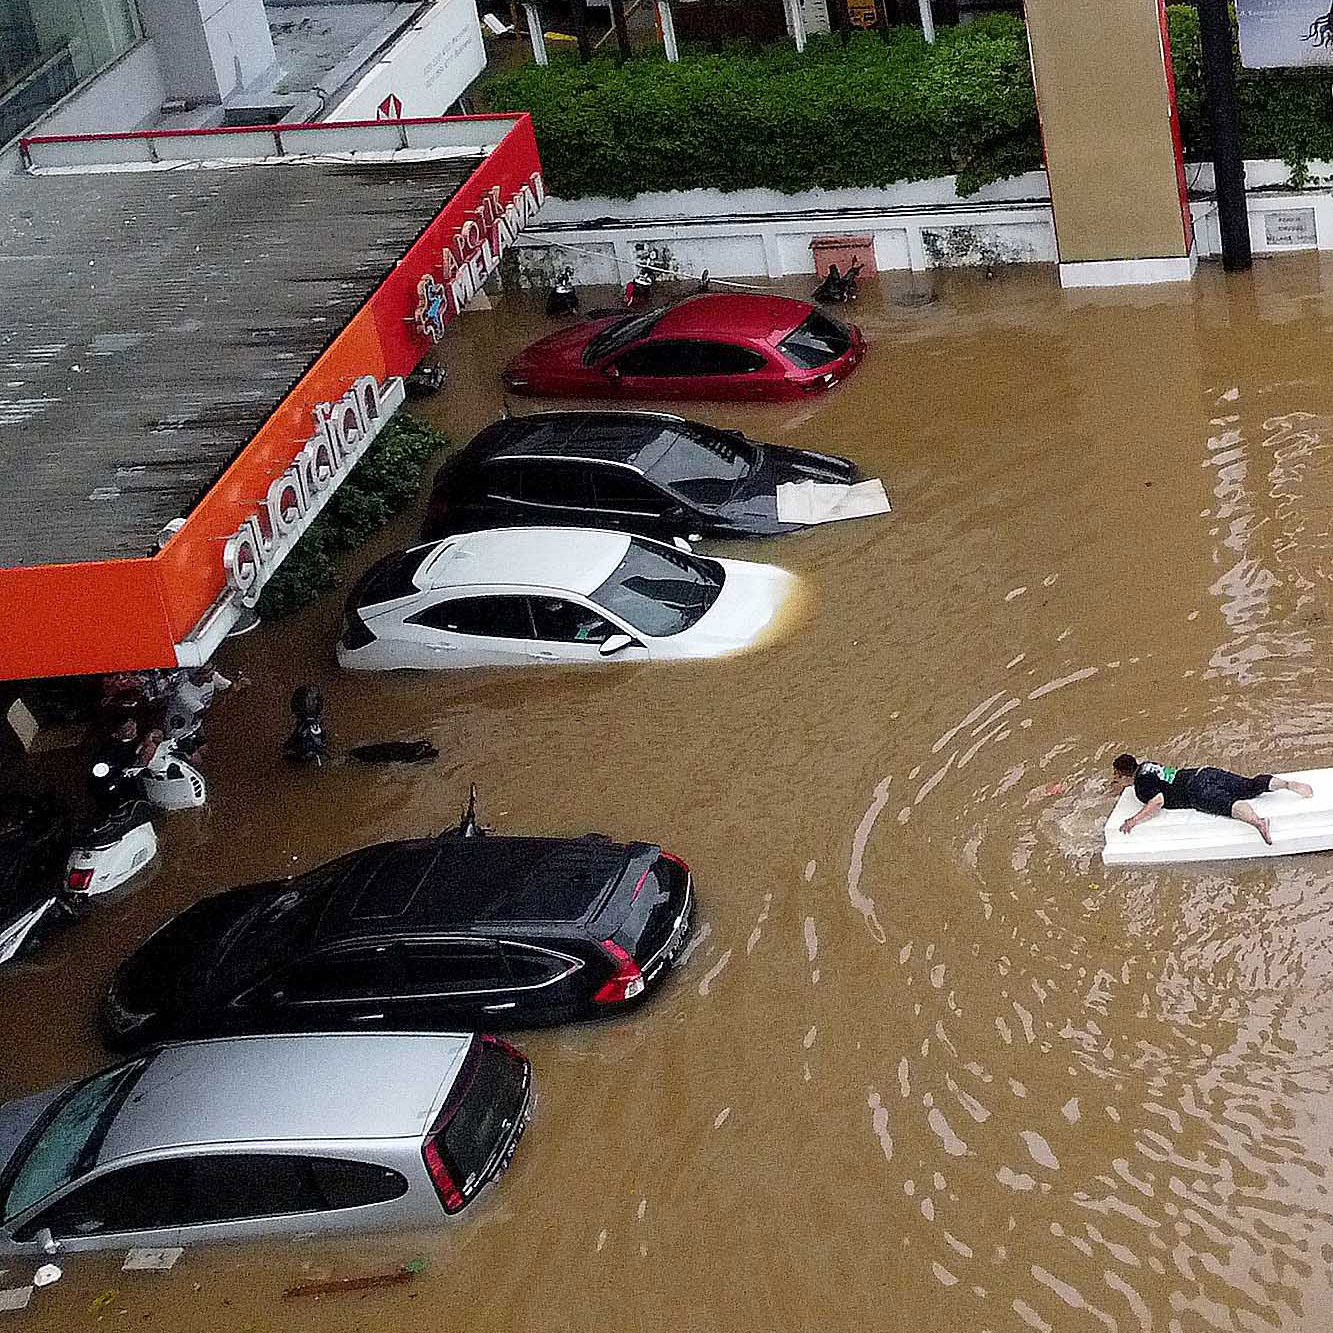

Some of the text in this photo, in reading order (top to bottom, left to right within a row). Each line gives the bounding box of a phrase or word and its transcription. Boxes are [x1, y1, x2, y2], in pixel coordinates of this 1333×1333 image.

[442, 185, 504, 281] APOTIK
[446, 171, 545, 315] MELAWAI
[223, 375, 386, 609] guardian
